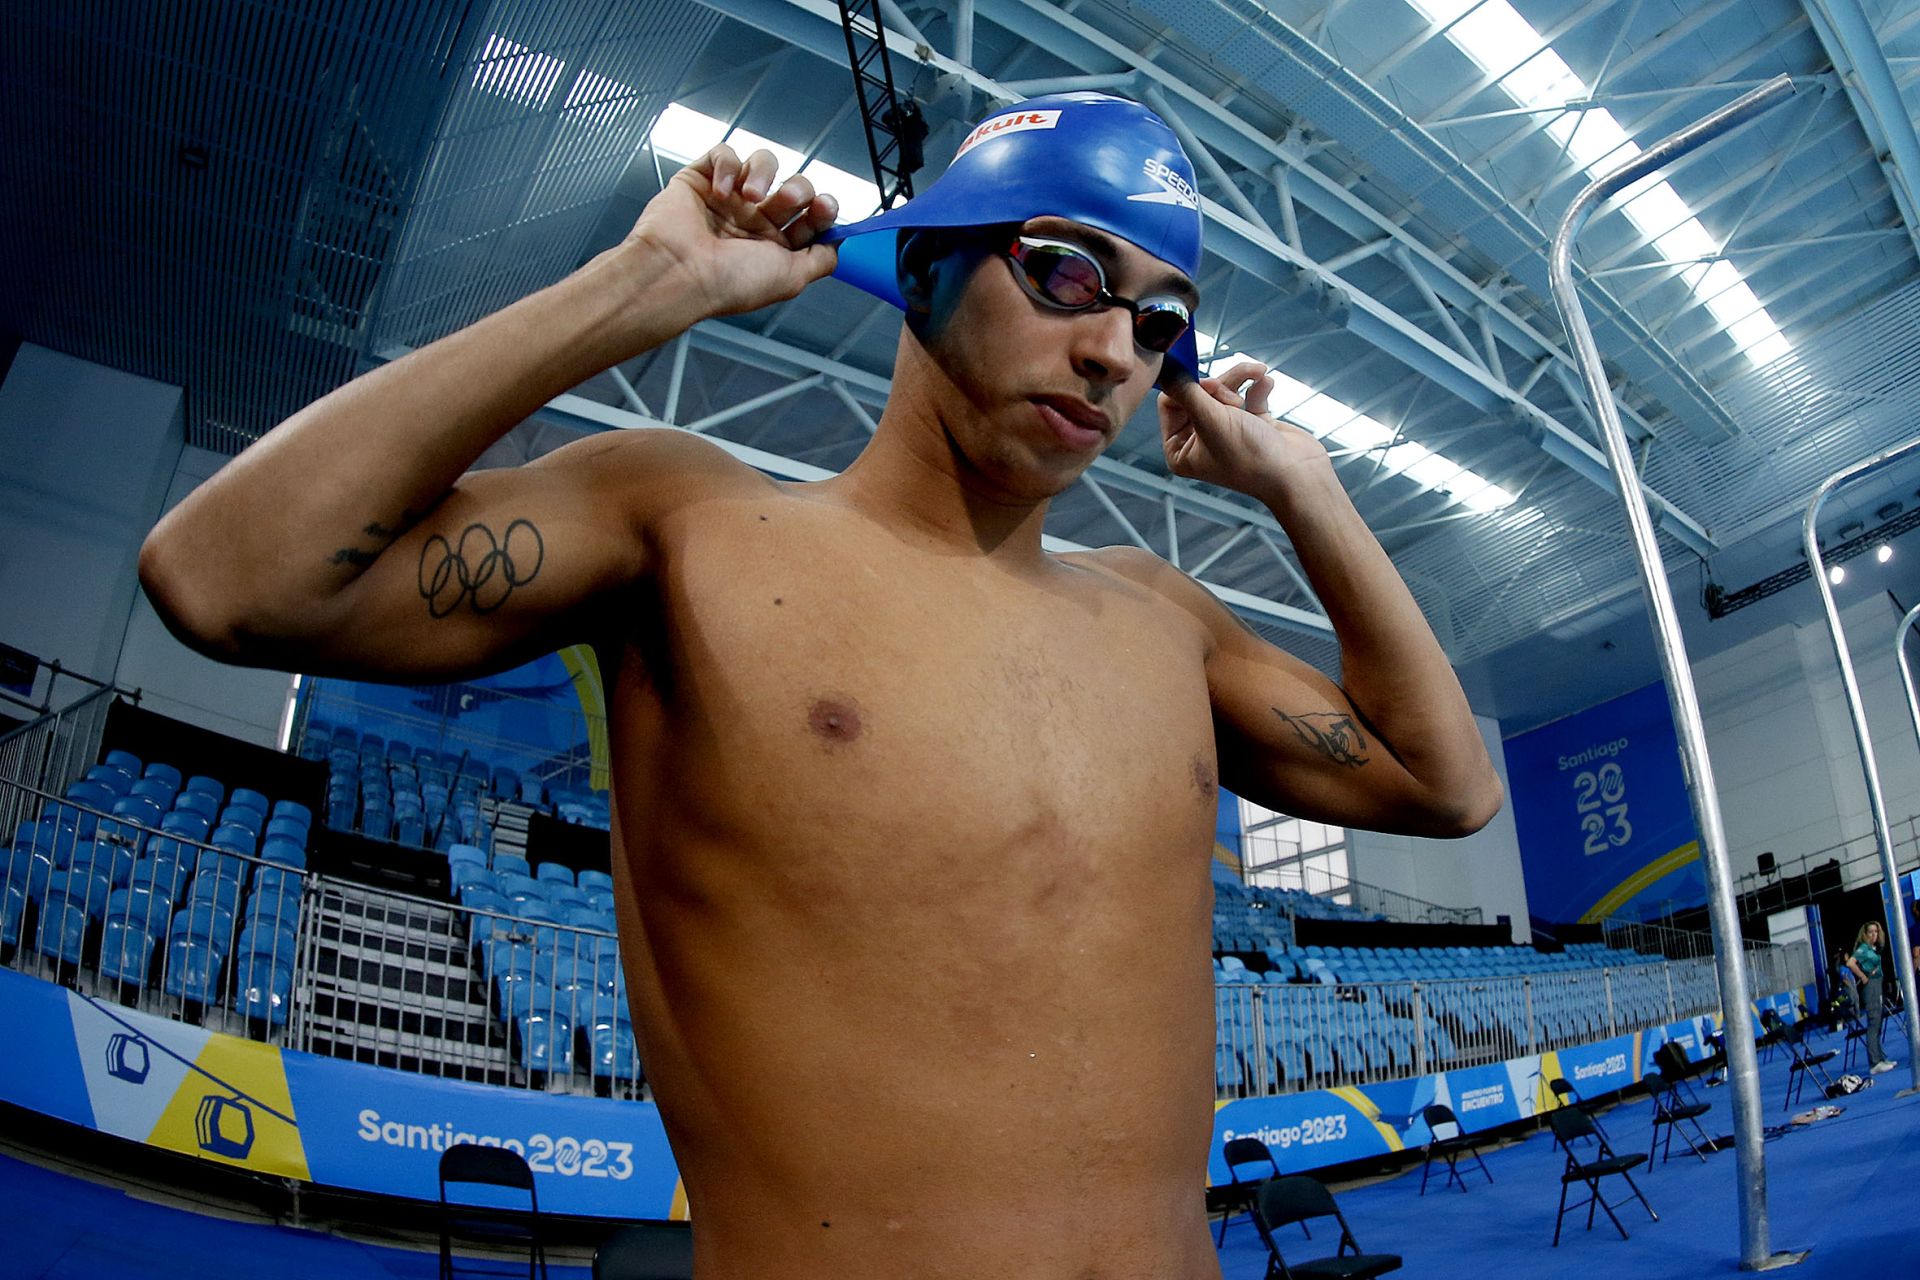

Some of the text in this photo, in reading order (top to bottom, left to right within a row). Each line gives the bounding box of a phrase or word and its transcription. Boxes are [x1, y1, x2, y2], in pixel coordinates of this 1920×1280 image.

[957, 114, 1048, 154] akult
[1143, 158, 1199, 206] SPEEDO
[1557, 737, 1629, 771] Santiago
[1573, 762, 1626, 814] 20
[1581, 803, 1633, 857] 23
[1574, 1053, 1626, 1080] Santiago 2023
[1223, 1114, 1347, 1149] Stiago 2023
[528, 1133, 634, 1181] 2023
